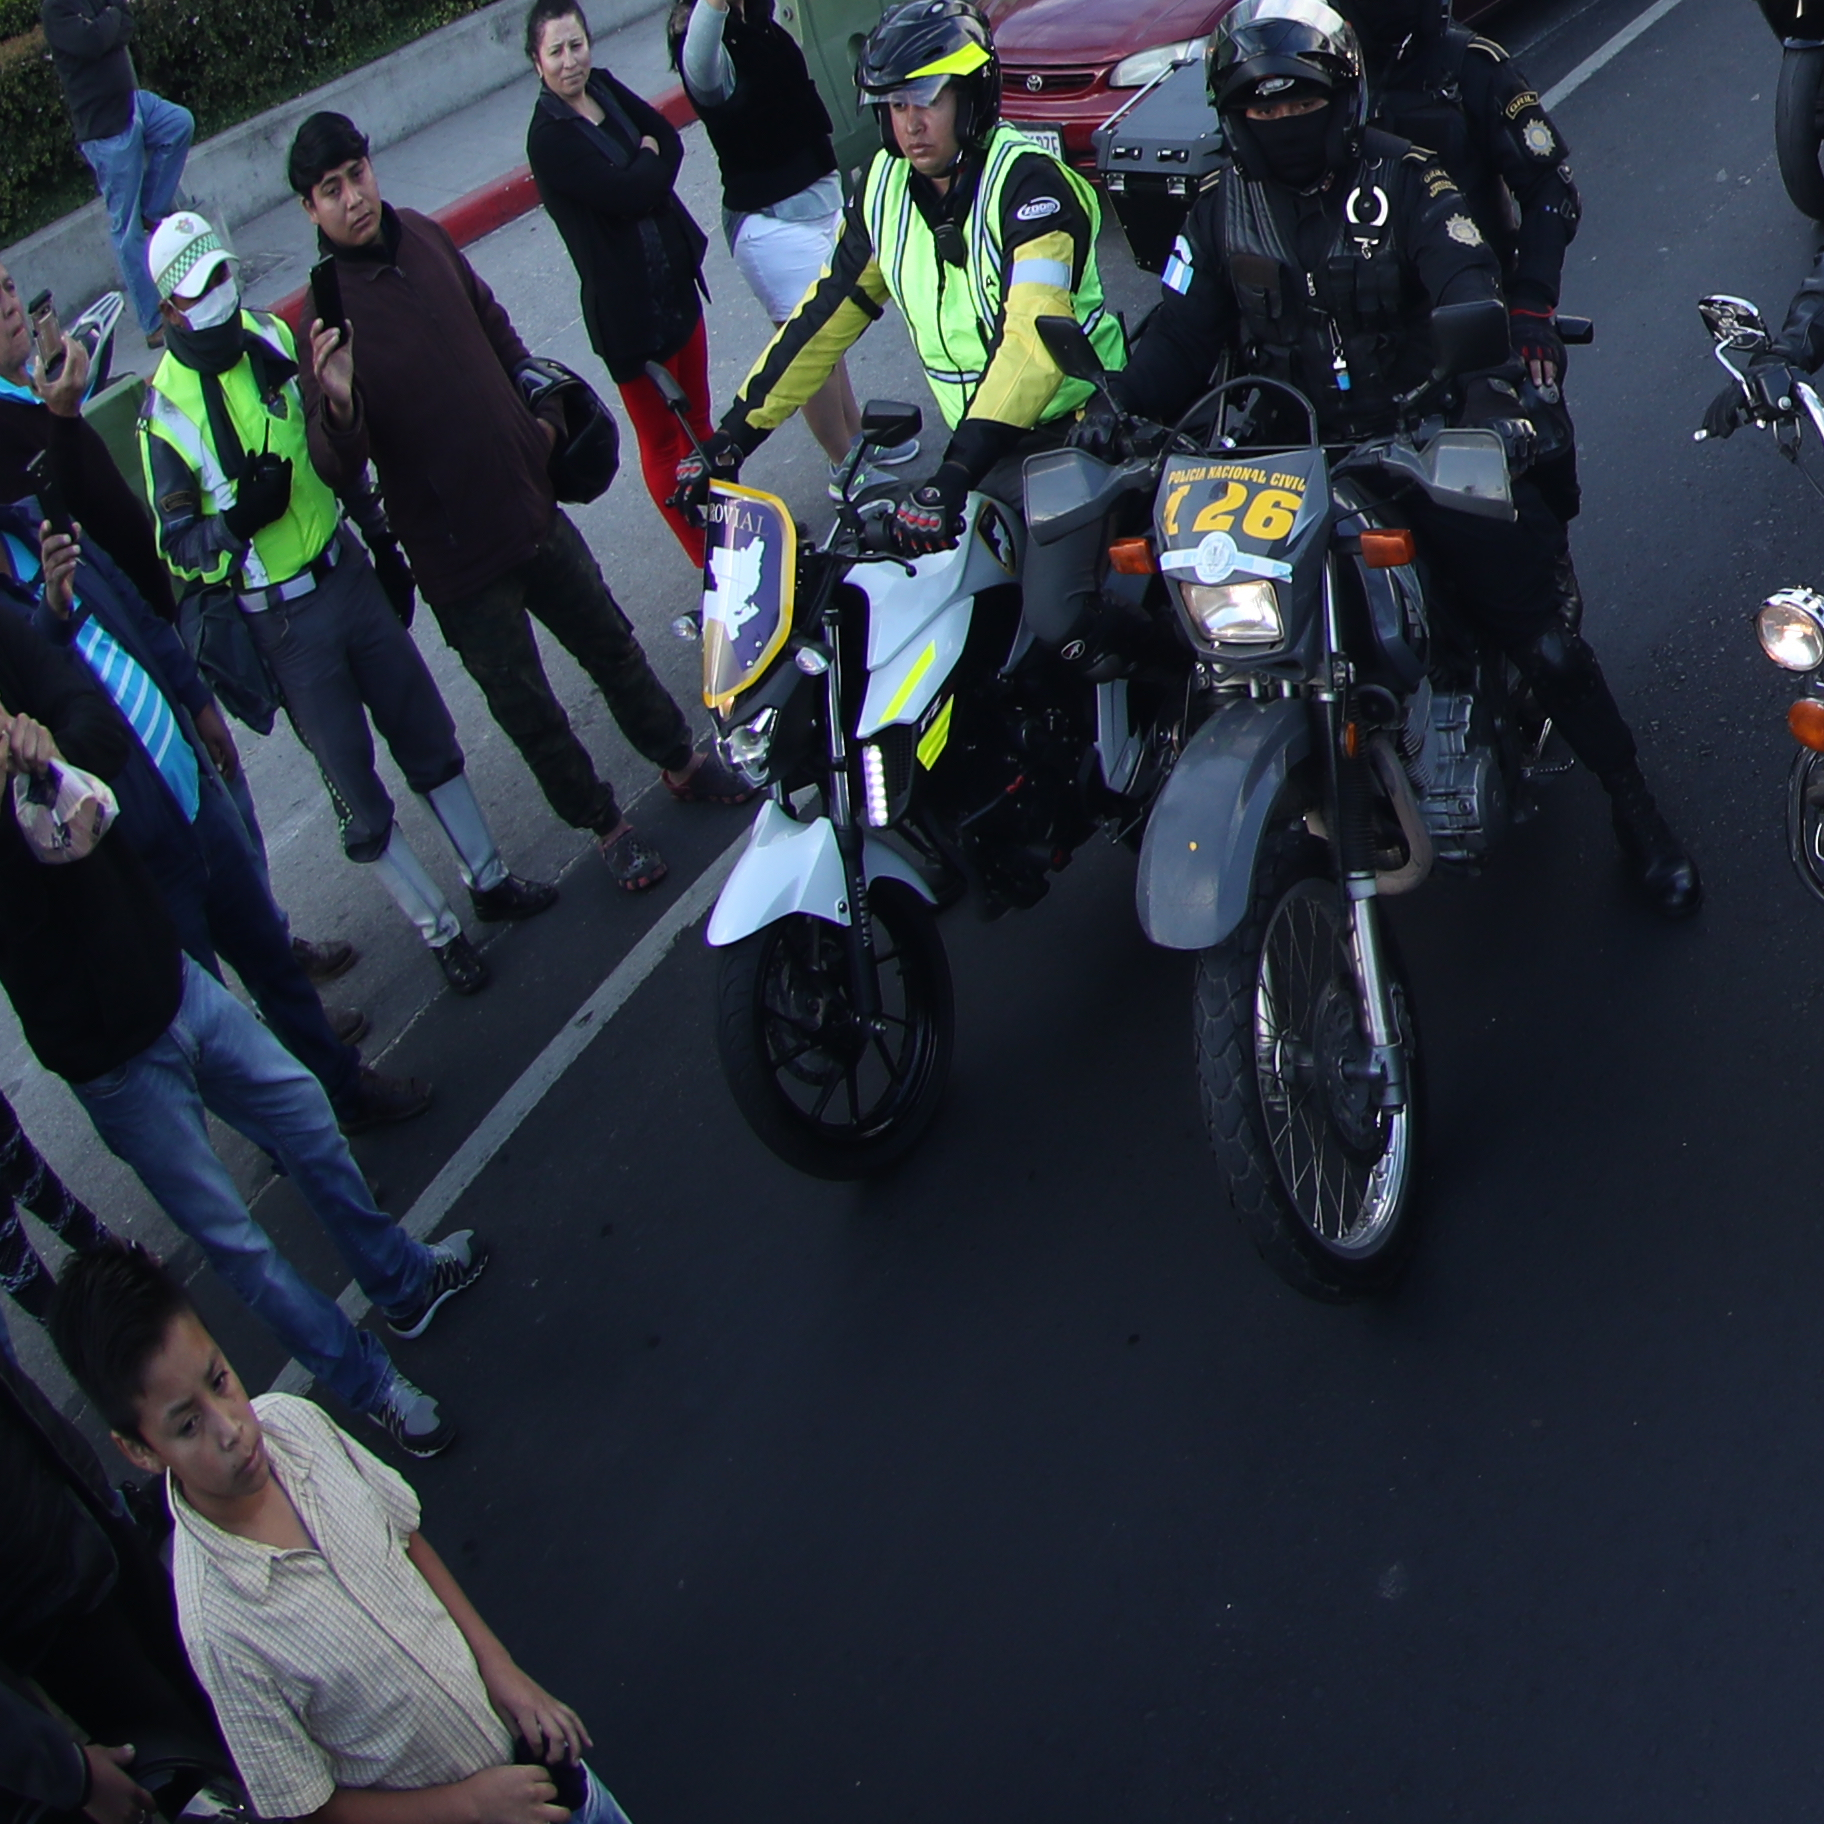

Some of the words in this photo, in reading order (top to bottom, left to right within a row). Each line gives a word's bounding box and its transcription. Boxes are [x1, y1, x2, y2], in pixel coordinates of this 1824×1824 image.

[1167, 466, 1206, 486] POLICIA
[1269, 472, 1307, 492] CIVIL
[855, 876, 872, 948] YAMAHA
